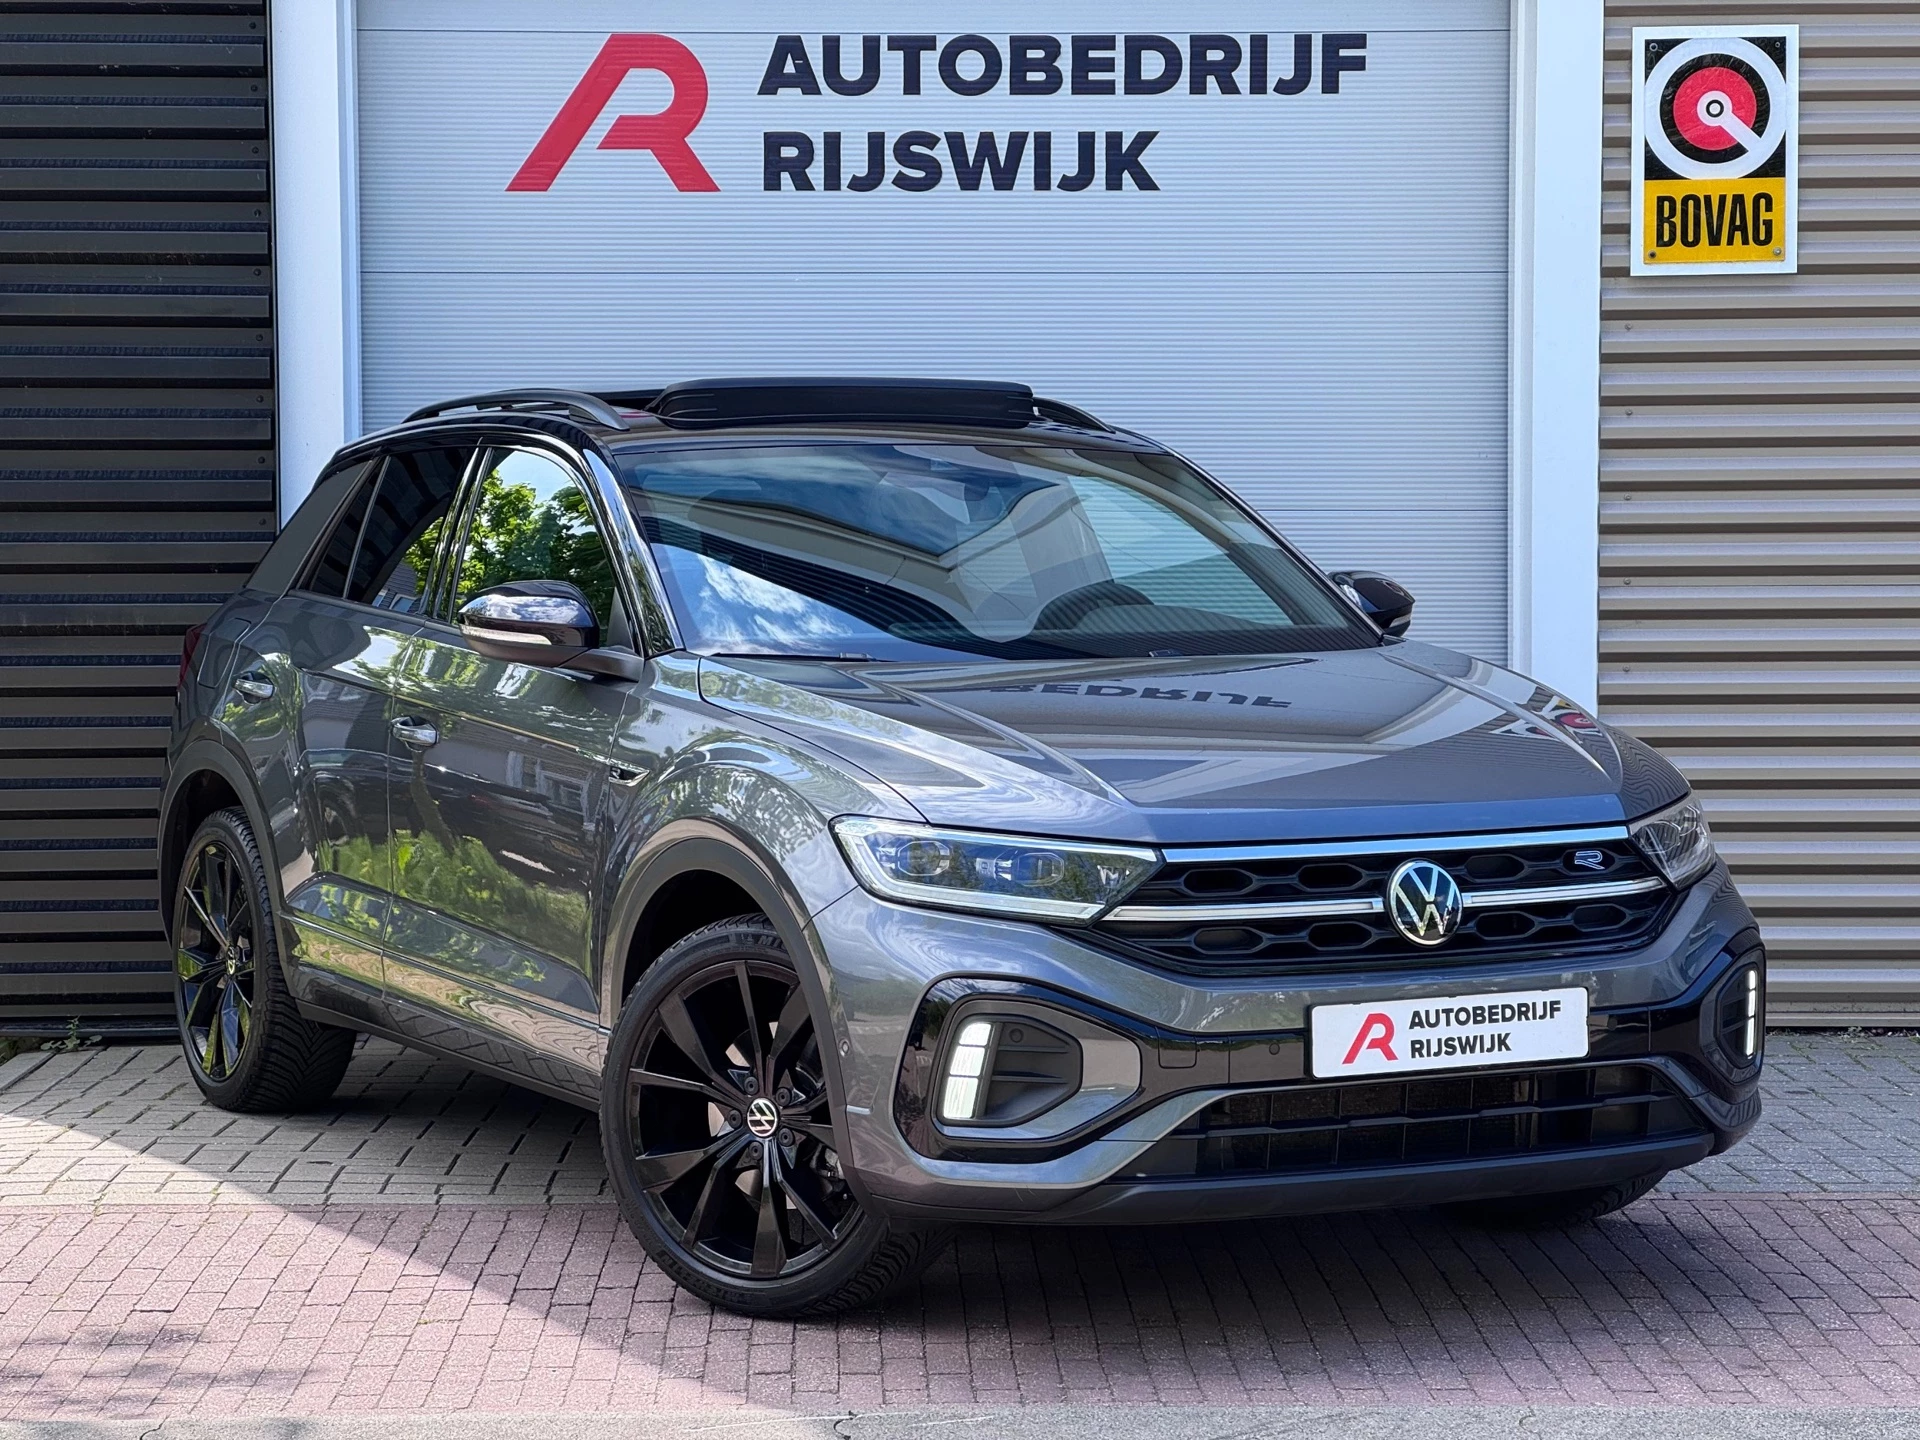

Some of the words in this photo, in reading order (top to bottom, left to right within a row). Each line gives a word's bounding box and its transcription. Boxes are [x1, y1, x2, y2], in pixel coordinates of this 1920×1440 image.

[757, 33, 1367, 96] AUTOBEDRIJF
[763, 131, 1160, 192] RIJSWIJK
[1656, 192, 1774, 248] BOVAG
[1408, 1000, 1562, 1030] AUTOBEDRIJF
[1410, 1032, 1512, 1059] RIJSWIJK
